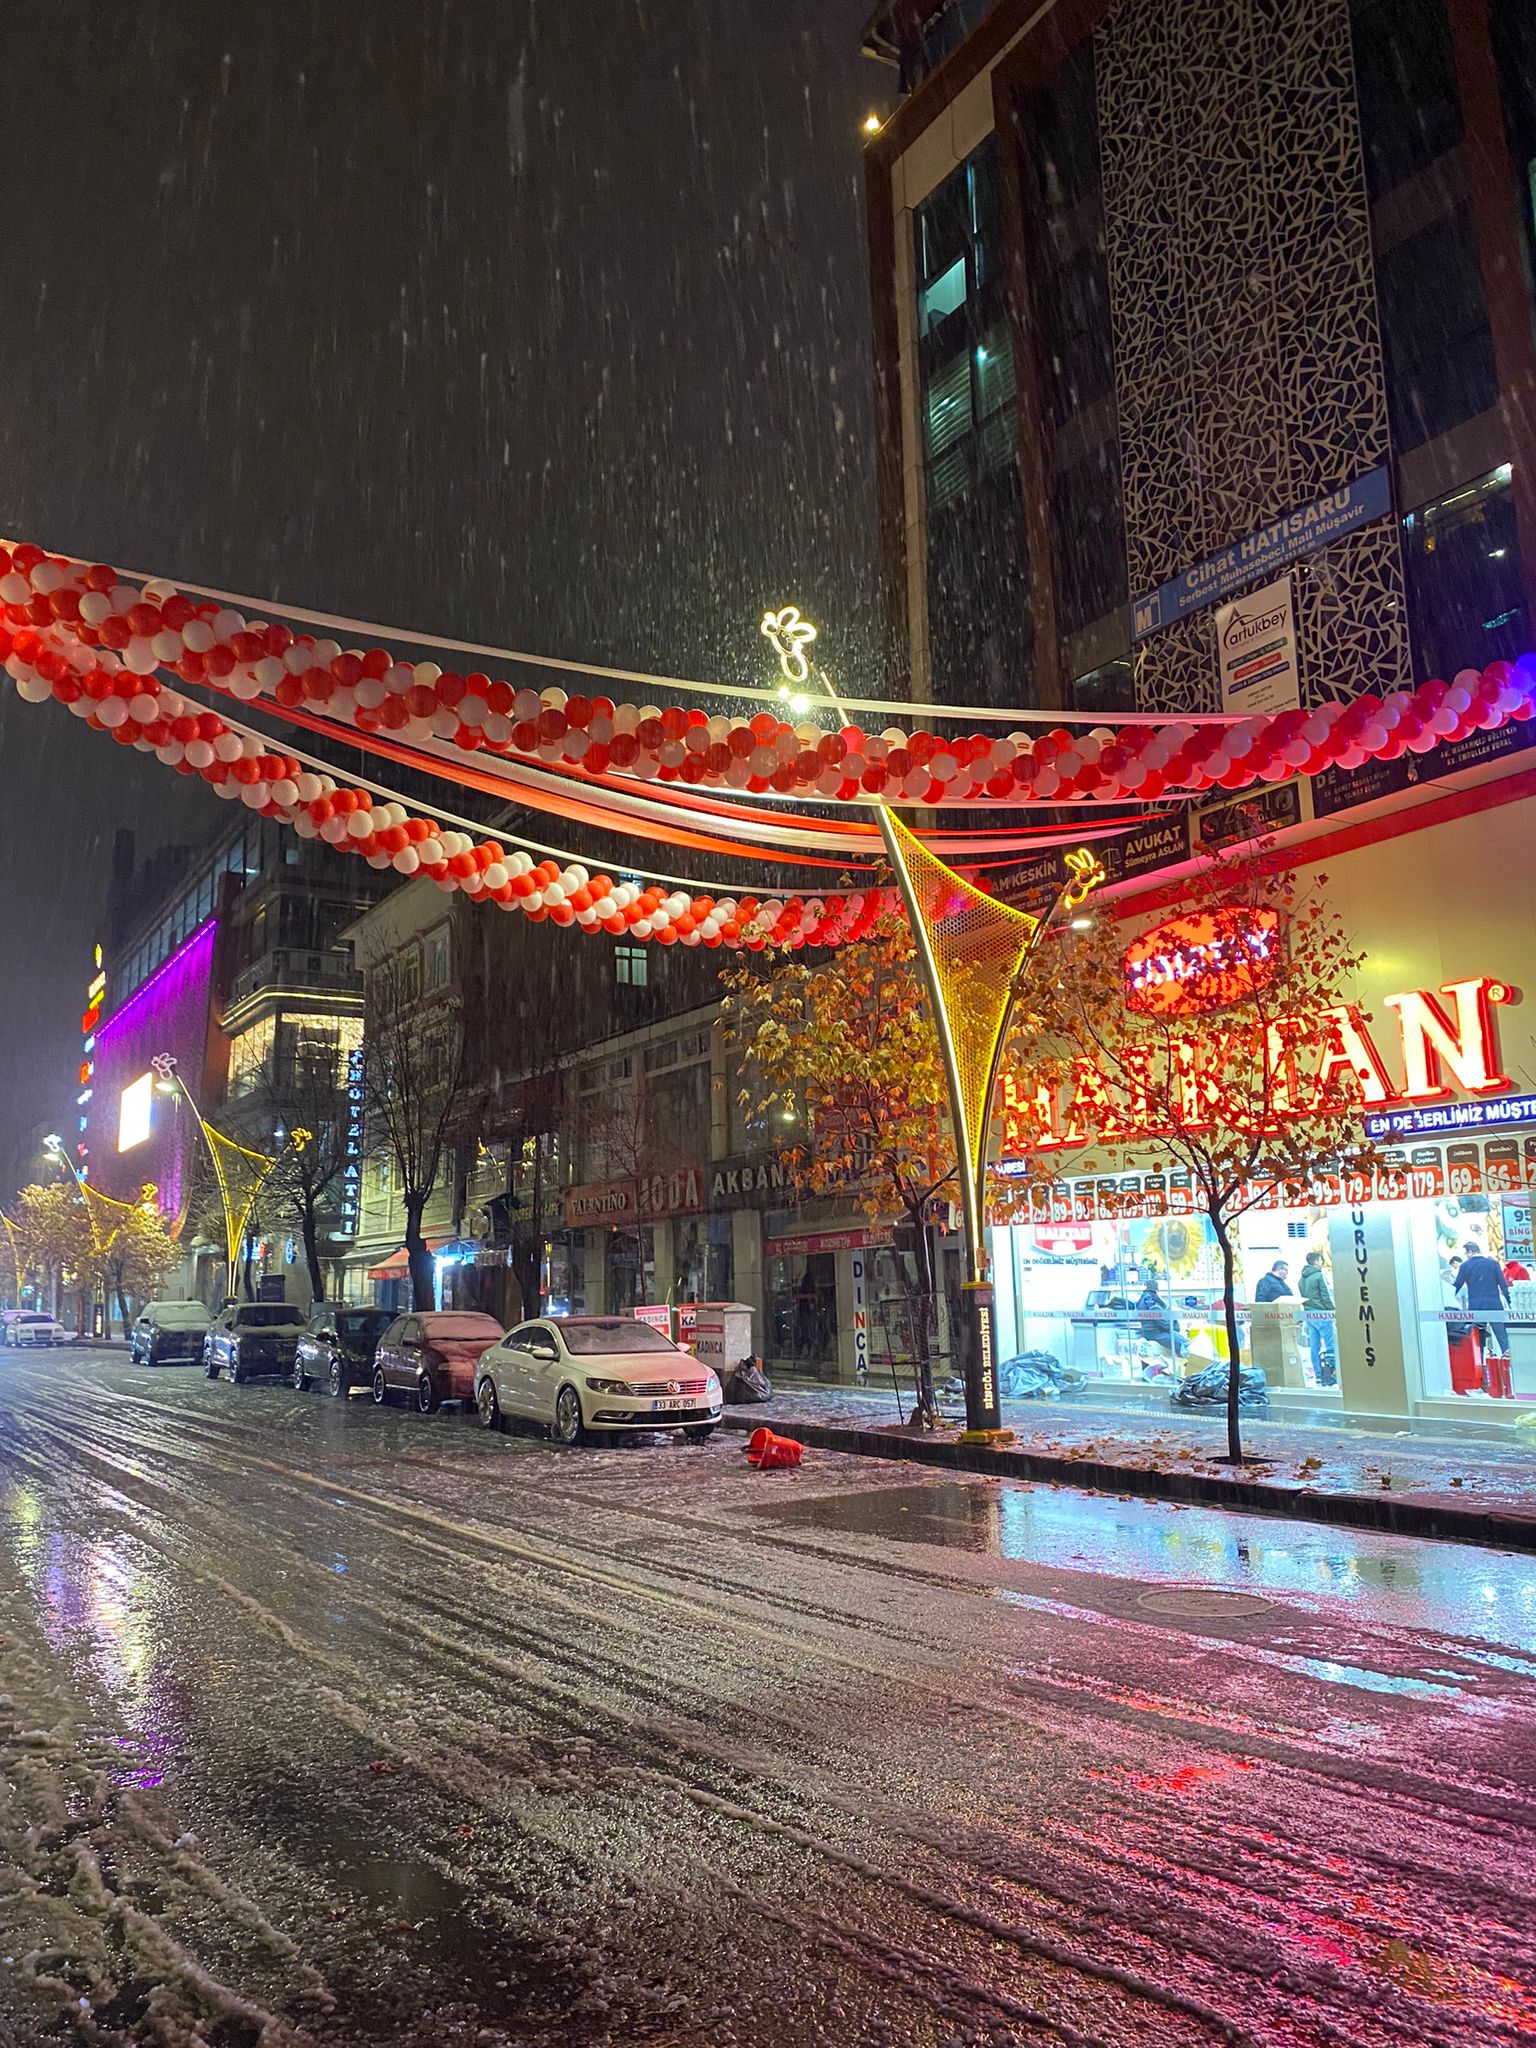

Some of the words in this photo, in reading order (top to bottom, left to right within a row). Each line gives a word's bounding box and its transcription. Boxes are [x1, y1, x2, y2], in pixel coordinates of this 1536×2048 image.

[1186, 549, 1236, 589] Cihat
[1241, 486, 1350, 560] HATISARU
[1179, 578, 1218, 607] Serbest
[1220, 546, 1285, 583] Muhasebeci
[1288, 532, 1313, 548] Mali
[1315, 504, 1365, 536] Müşavir
[1229, 610, 1287, 645] artukbey
[1124, 851, 1158, 868] Sümeyra
[1157, 841, 1184, 858] ASLAN
[1125, 826, 1181, 856] AVUKAT
[1012, 860, 1057, 887] KESKİN
[1370, 1118, 1391, 1134] EN
[1351, 1202, 1376, 1367] URUYEMİŞ
[697, 1340, 723, 1354] KADINCA
[978, 1306, 992, 1368] BELEDİYESİ
[657, 1400, 666, 1409] 33
[669, 1399, 681, 1409] ARC
[682, 1399, 694, 1407] 057
[981, 1369, 993, 1410] BİNGÖL
